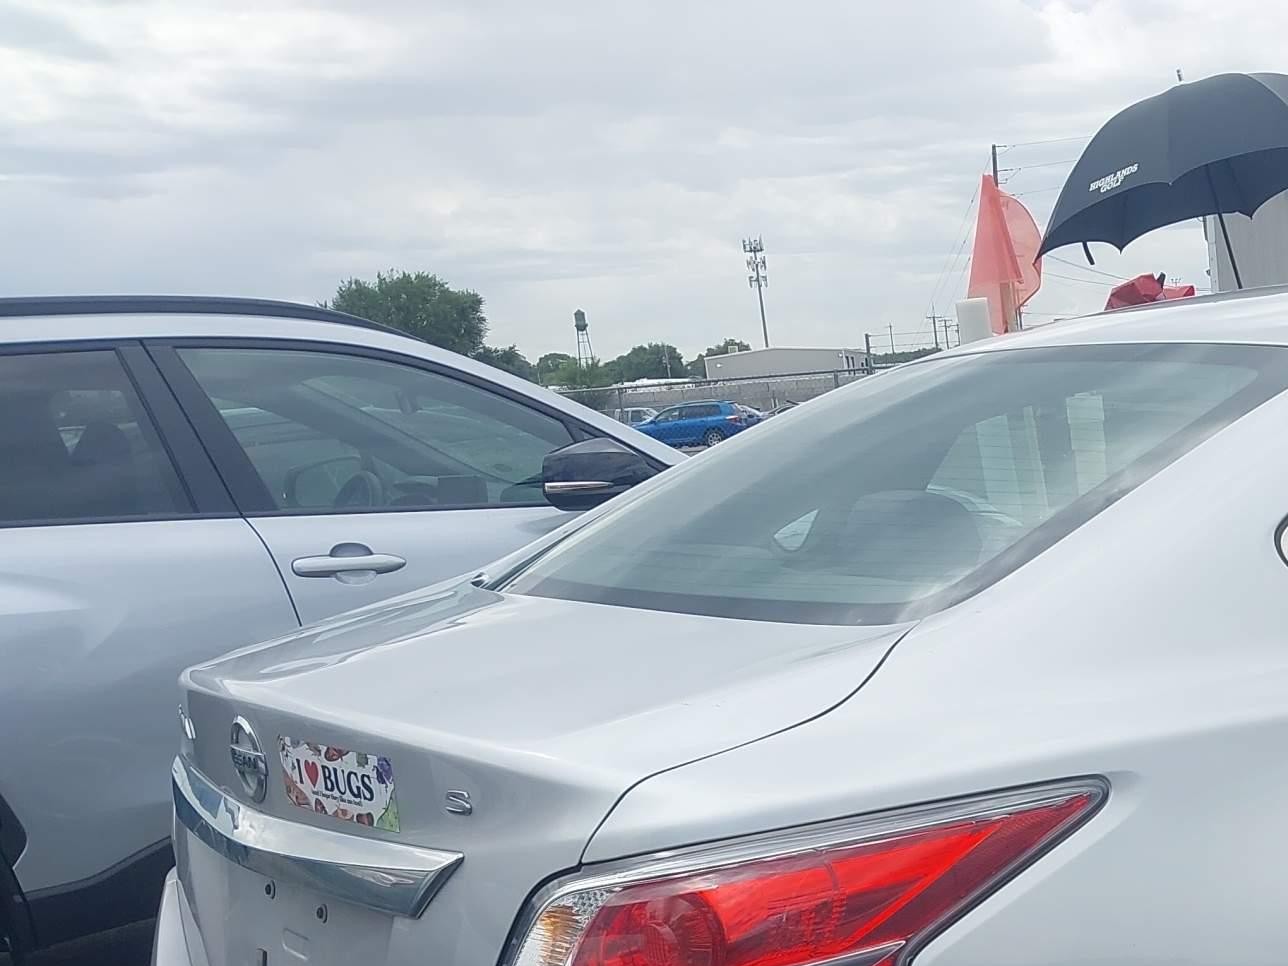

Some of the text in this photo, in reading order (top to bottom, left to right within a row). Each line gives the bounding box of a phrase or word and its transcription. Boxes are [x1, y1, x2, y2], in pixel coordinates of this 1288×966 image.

[296, 758, 375, 802] I BUGS
[445, 789, 473, 817] S
